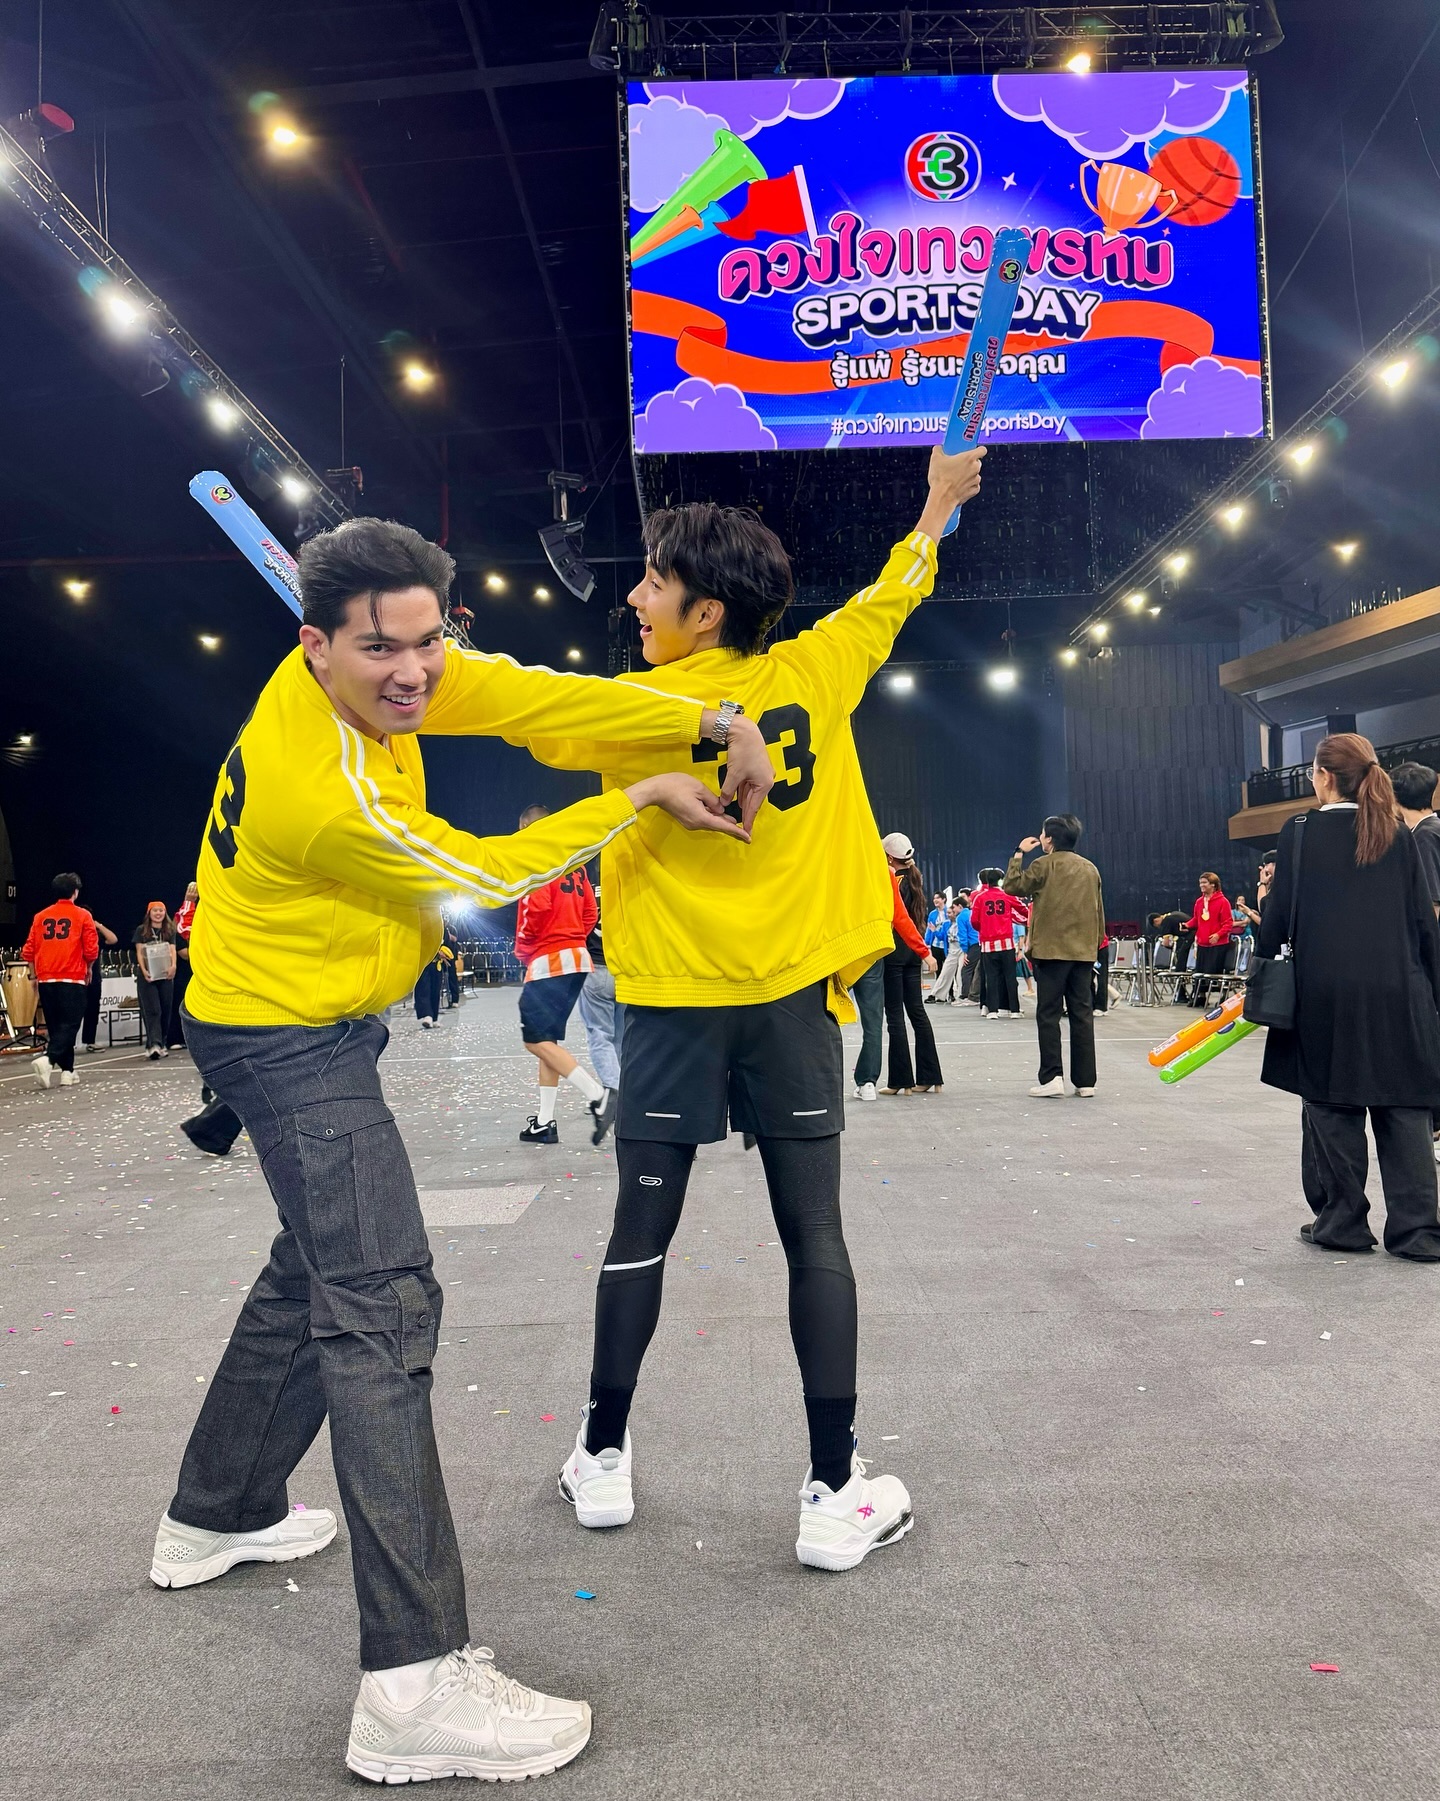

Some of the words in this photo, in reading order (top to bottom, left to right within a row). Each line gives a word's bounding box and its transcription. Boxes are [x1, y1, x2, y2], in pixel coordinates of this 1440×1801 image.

[796, 284, 984, 340] SPORTS
[831, 350, 892, 388] รู้แพ้
[901, 349, 964, 386] รู้ชนะ
[996, 354, 1066, 382] จคุณ
[966, 352, 984, 398] SPORTS
[958, 399, 974, 422] DAY
[265, 557, 300, 592] SPORTS
[985, 900, 1005, 915] 33
[42, 918, 71, 940] 33
